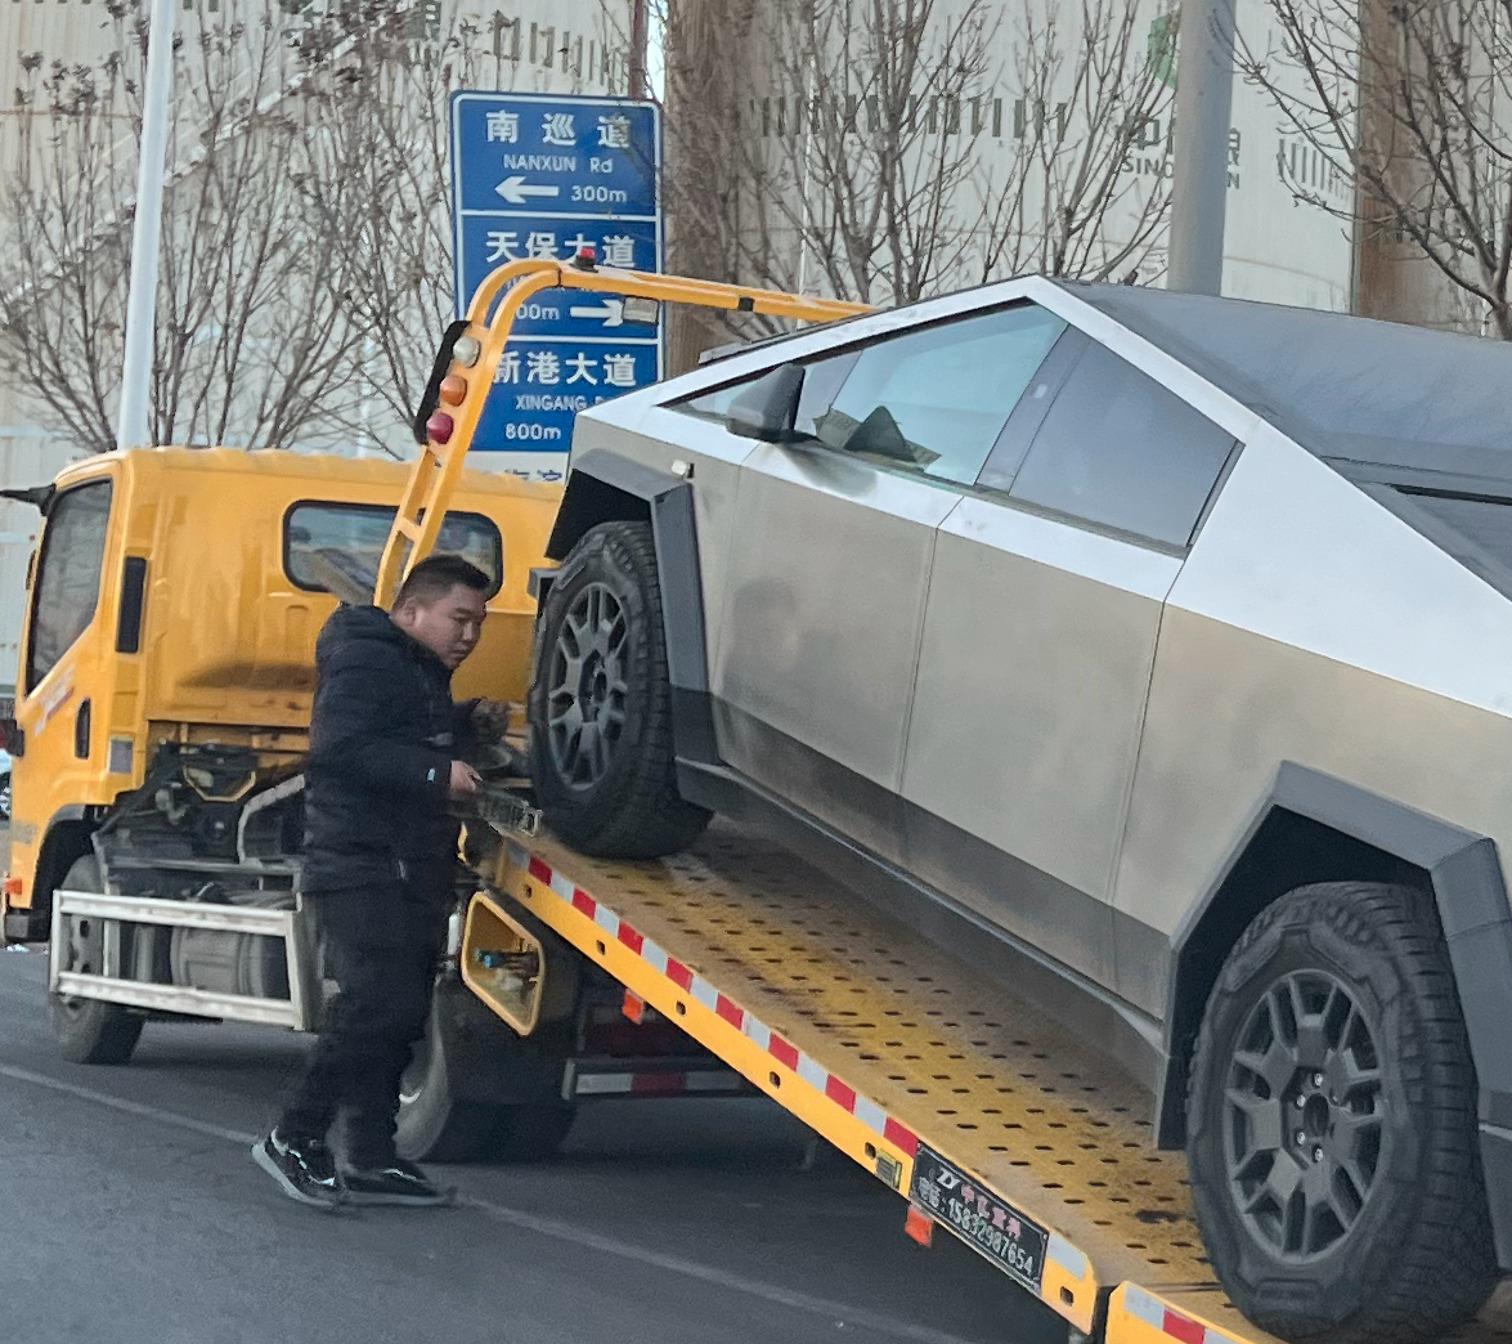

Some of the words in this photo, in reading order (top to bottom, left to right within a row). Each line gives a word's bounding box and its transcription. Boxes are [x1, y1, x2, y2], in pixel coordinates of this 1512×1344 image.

[485, 109, 631, 148] 南巡道
[503, 154, 576, 172] NANXUN
[590, 157, 613, 174] Rd
[571, 185, 627, 203] 300m
[486, 231, 636, 268] 天保大道
[515, 303, 561, 320] 00m
[492, 351, 637, 387] 新港大道
[515, 395, 588, 411] XINGANG
[505, 423, 562, 440] 800m
